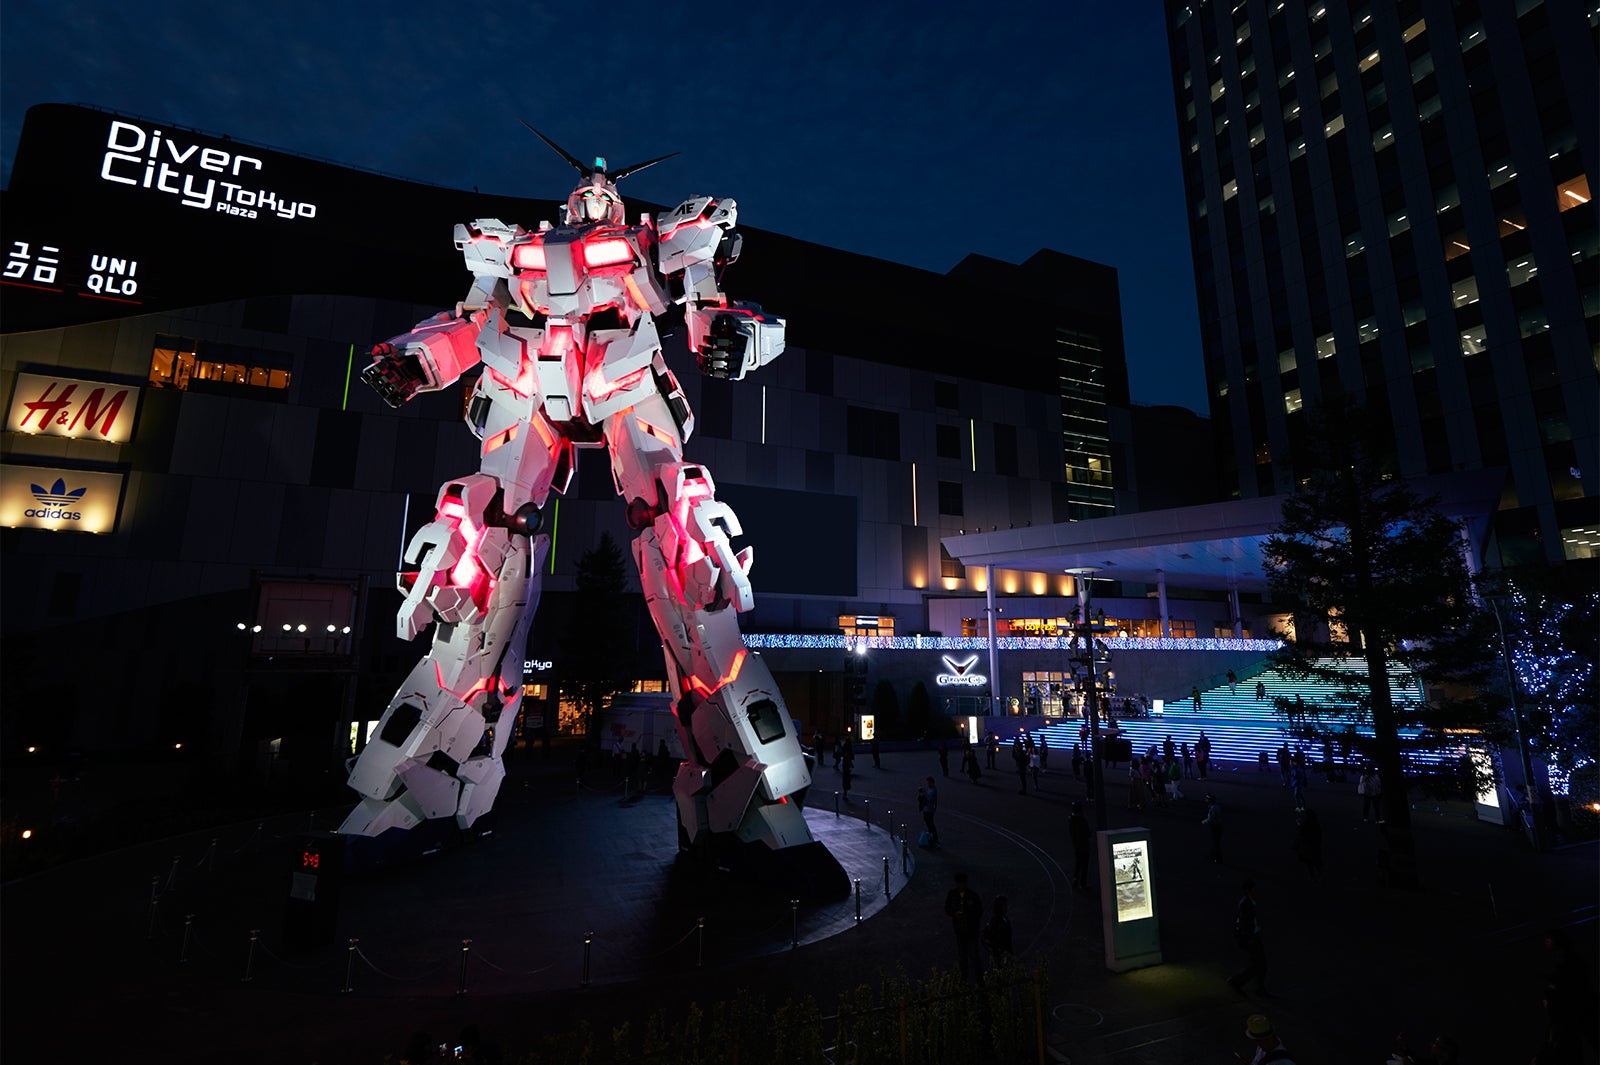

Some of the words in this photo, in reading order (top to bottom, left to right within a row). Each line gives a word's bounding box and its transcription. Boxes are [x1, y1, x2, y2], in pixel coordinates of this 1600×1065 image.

[107, 120, 262, 176] Diver
[101, 151, 215, 209] City
[216, 202, 258, 219] Plaza
[9, 241, 59, 264] ユニ
[2, 260, 58, 284] クロ
[91, 255, 137, 277] UNI
[87, 274, 138, 295] QLO
[20, 382, 128, 437] H&M
[24, 508, 81, 521] adidas
[524, 660, 553, 671] okyo
